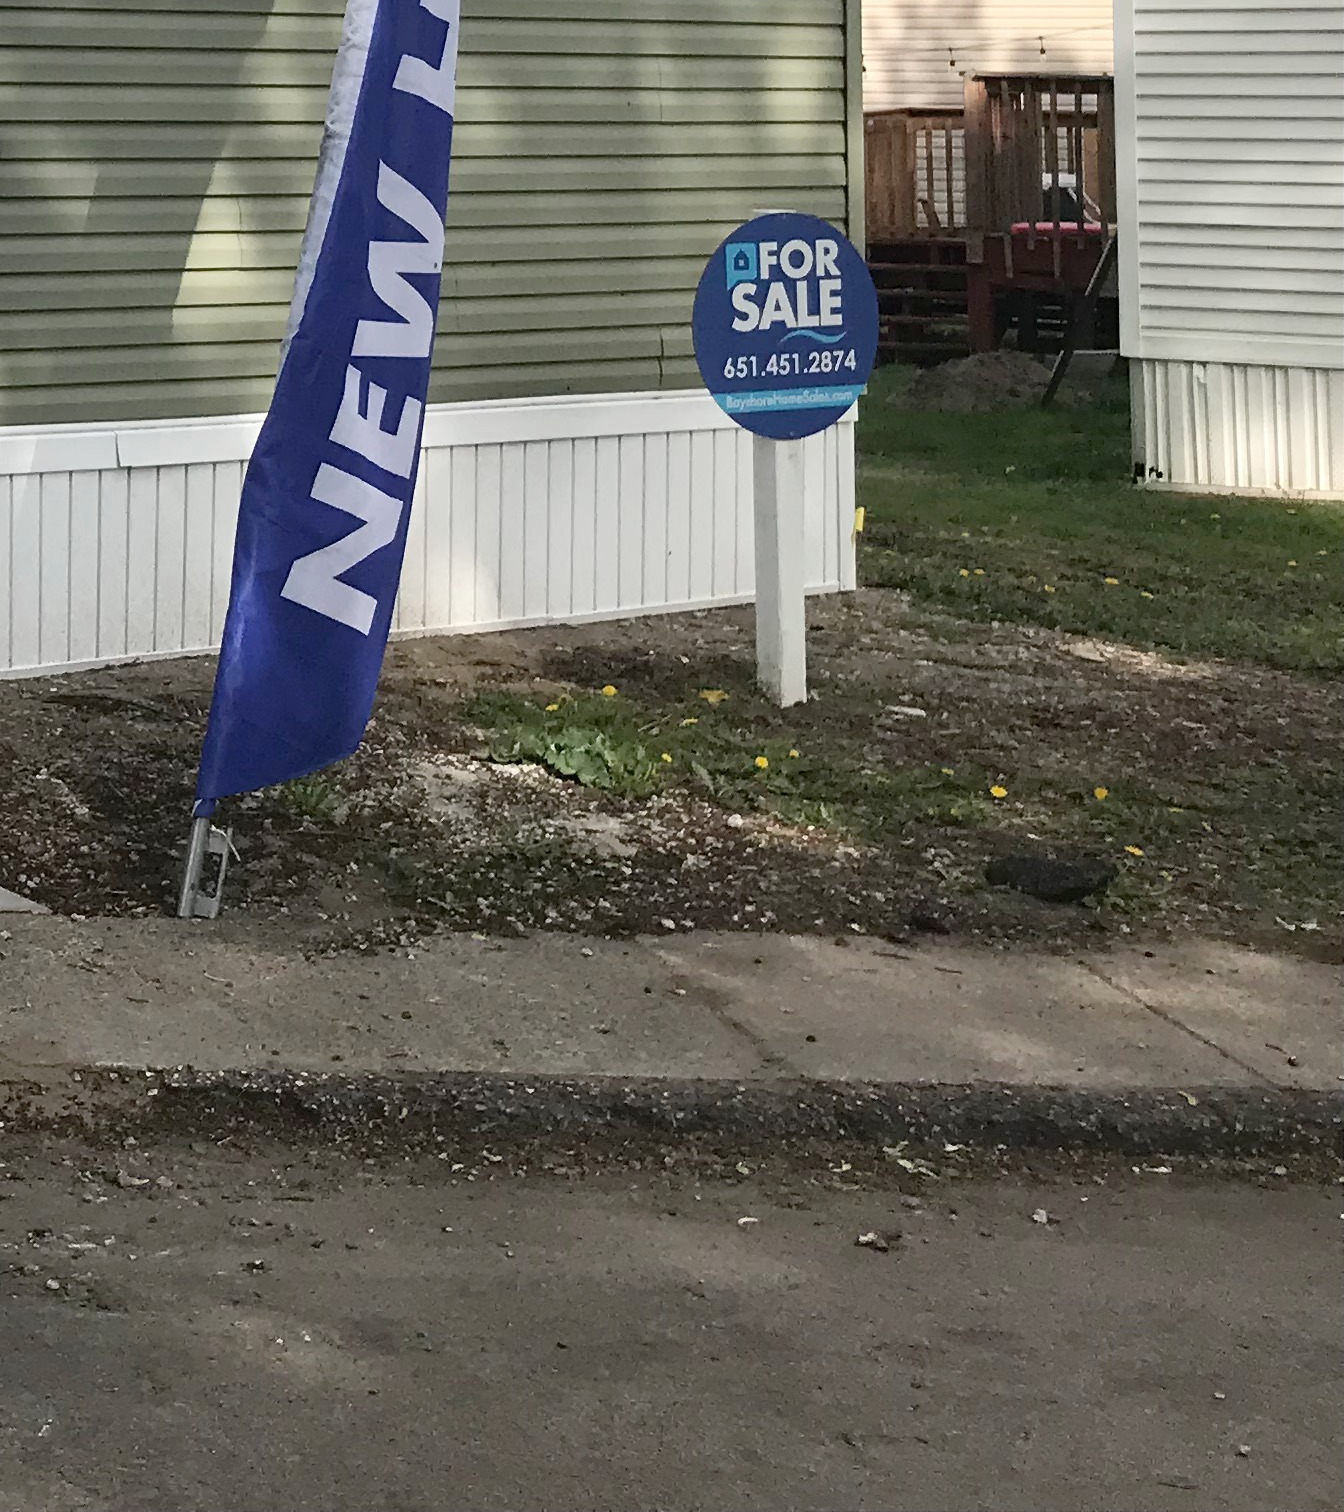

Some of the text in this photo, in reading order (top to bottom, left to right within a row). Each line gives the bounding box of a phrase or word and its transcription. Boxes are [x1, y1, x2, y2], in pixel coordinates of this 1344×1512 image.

[758, 238, 842, 280] FOR
[731, 278, 843, 333] SALE
[723, 348, 857, 379] 651.451.2874
[280, 159, 445, 636] NEW
[725, 389, 853, 410] BayshoreHomeSales.com
